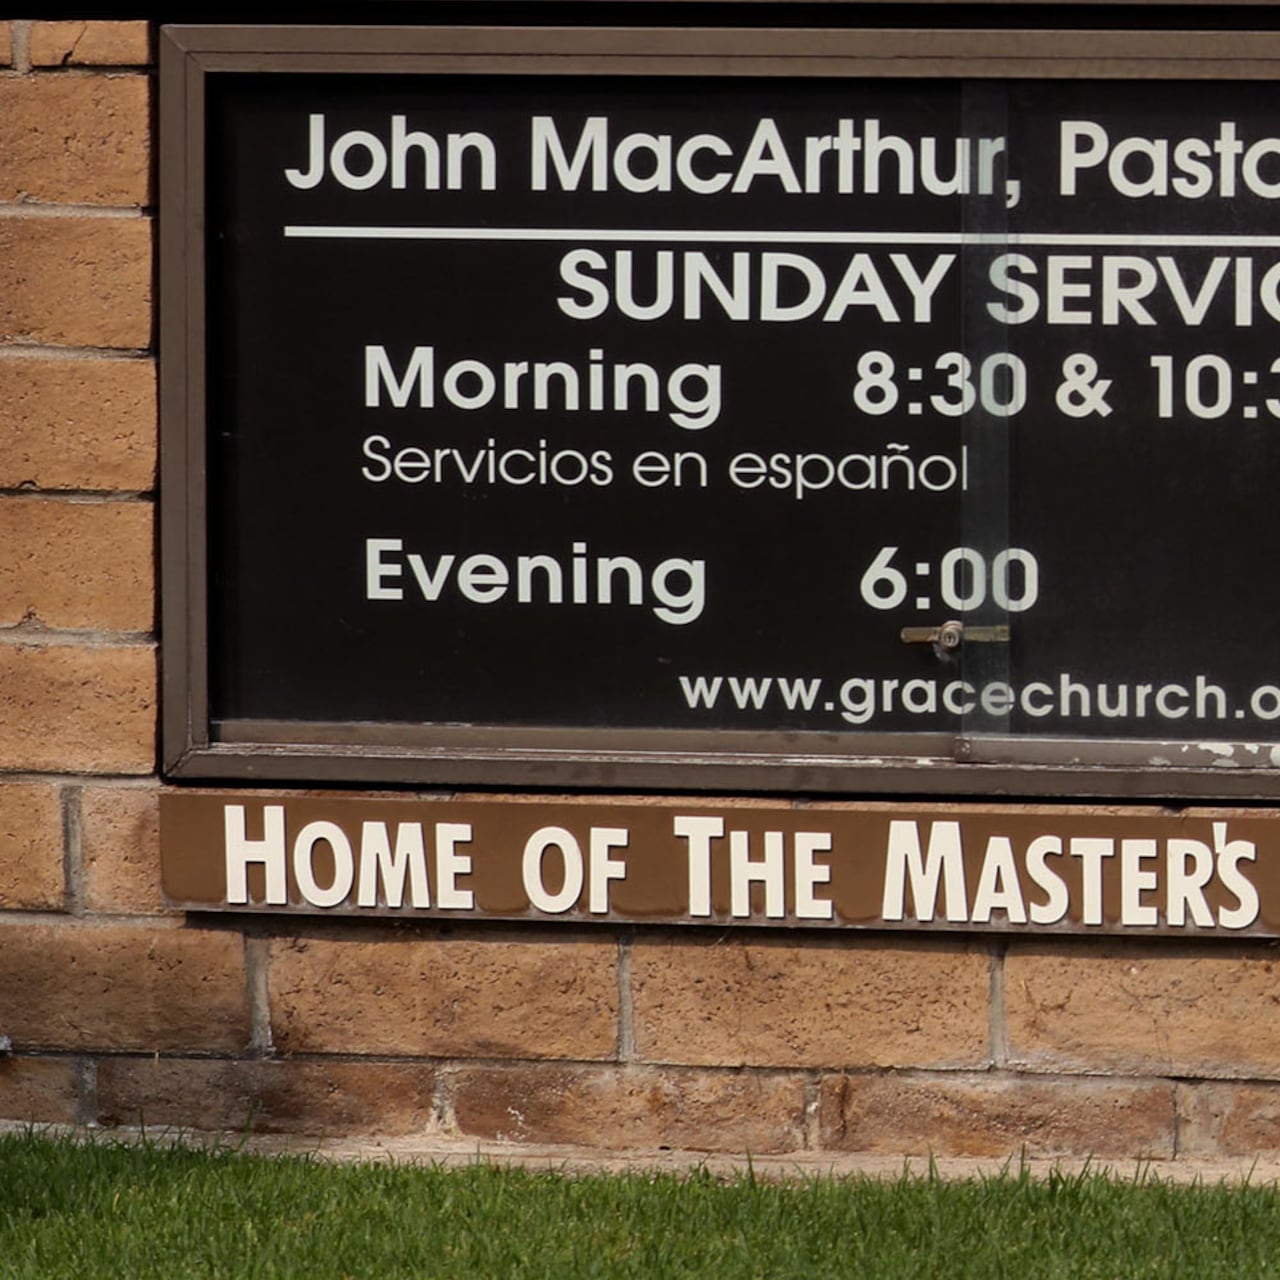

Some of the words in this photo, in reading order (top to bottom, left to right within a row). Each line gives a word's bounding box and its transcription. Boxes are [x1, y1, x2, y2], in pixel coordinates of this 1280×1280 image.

[284, 114, 496, 191] John
[531, 116, 1020, 209] MacArthur,
[557, 250, 956, 323] SUNDAY
[365, 345, 721, 430] Morning
[853, 350, 1027, 417] 8:30
[1055, 353, 1113, 418] &
[362, 435, 613, 486] Servicios
[633, 451, 707, 487] en
[729, 443, 968, 500] español
[366, 538, 705, 625] Evening
[860, 546, 1038, 612] 6:00
[224, 805, 473, 909] HOME
[522, 826, 628, 913] OF
[674, 815, 832, 919] THE
[882, 820, 1259, 929] MASTER'S
